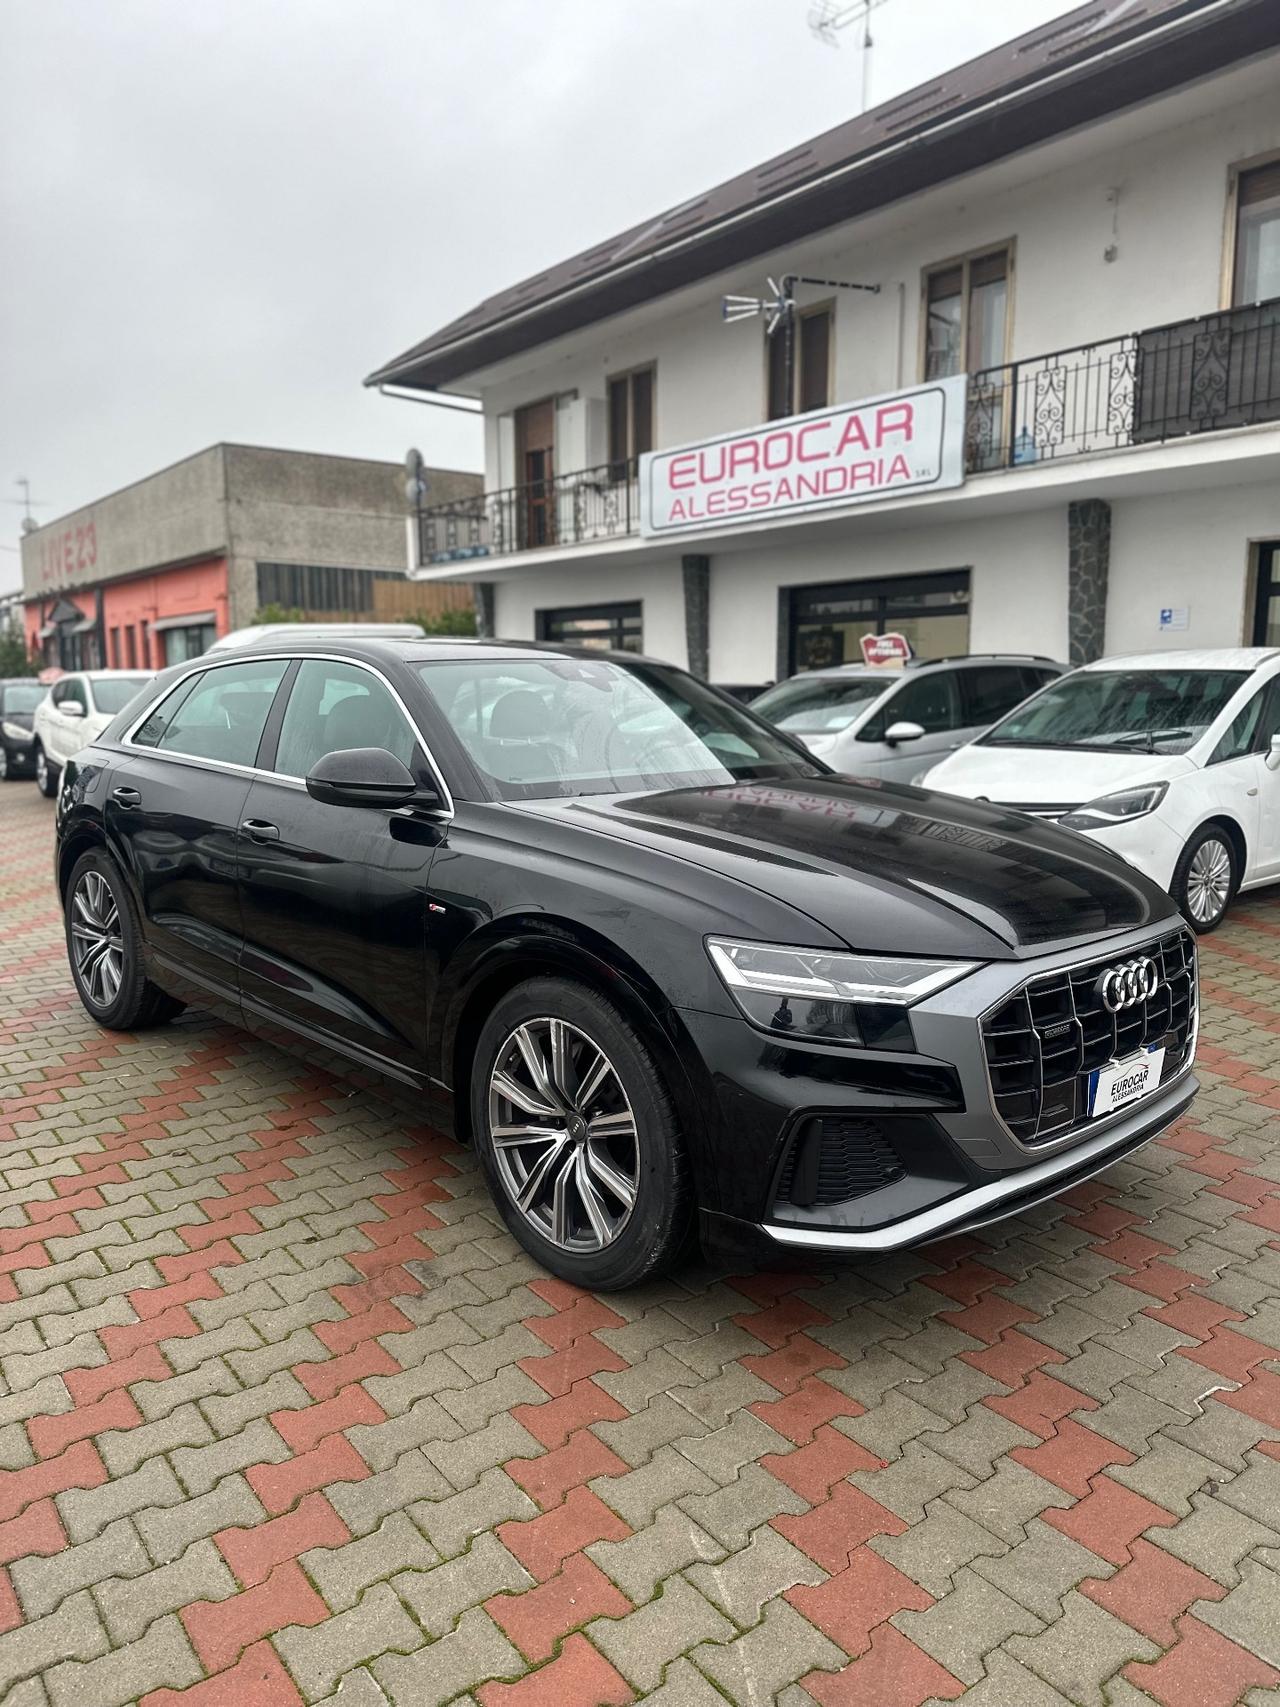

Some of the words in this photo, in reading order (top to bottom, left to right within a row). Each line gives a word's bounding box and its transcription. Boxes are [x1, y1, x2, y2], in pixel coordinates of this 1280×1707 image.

[669, 403, 913, 490] EUROCAR
[668, 454, 911, 522] ALESSANDRIA
[1110, 1069, 1149, 1097] EUROCAR
[1111, 1083, 1144, 1103] ALESSANDRIA
